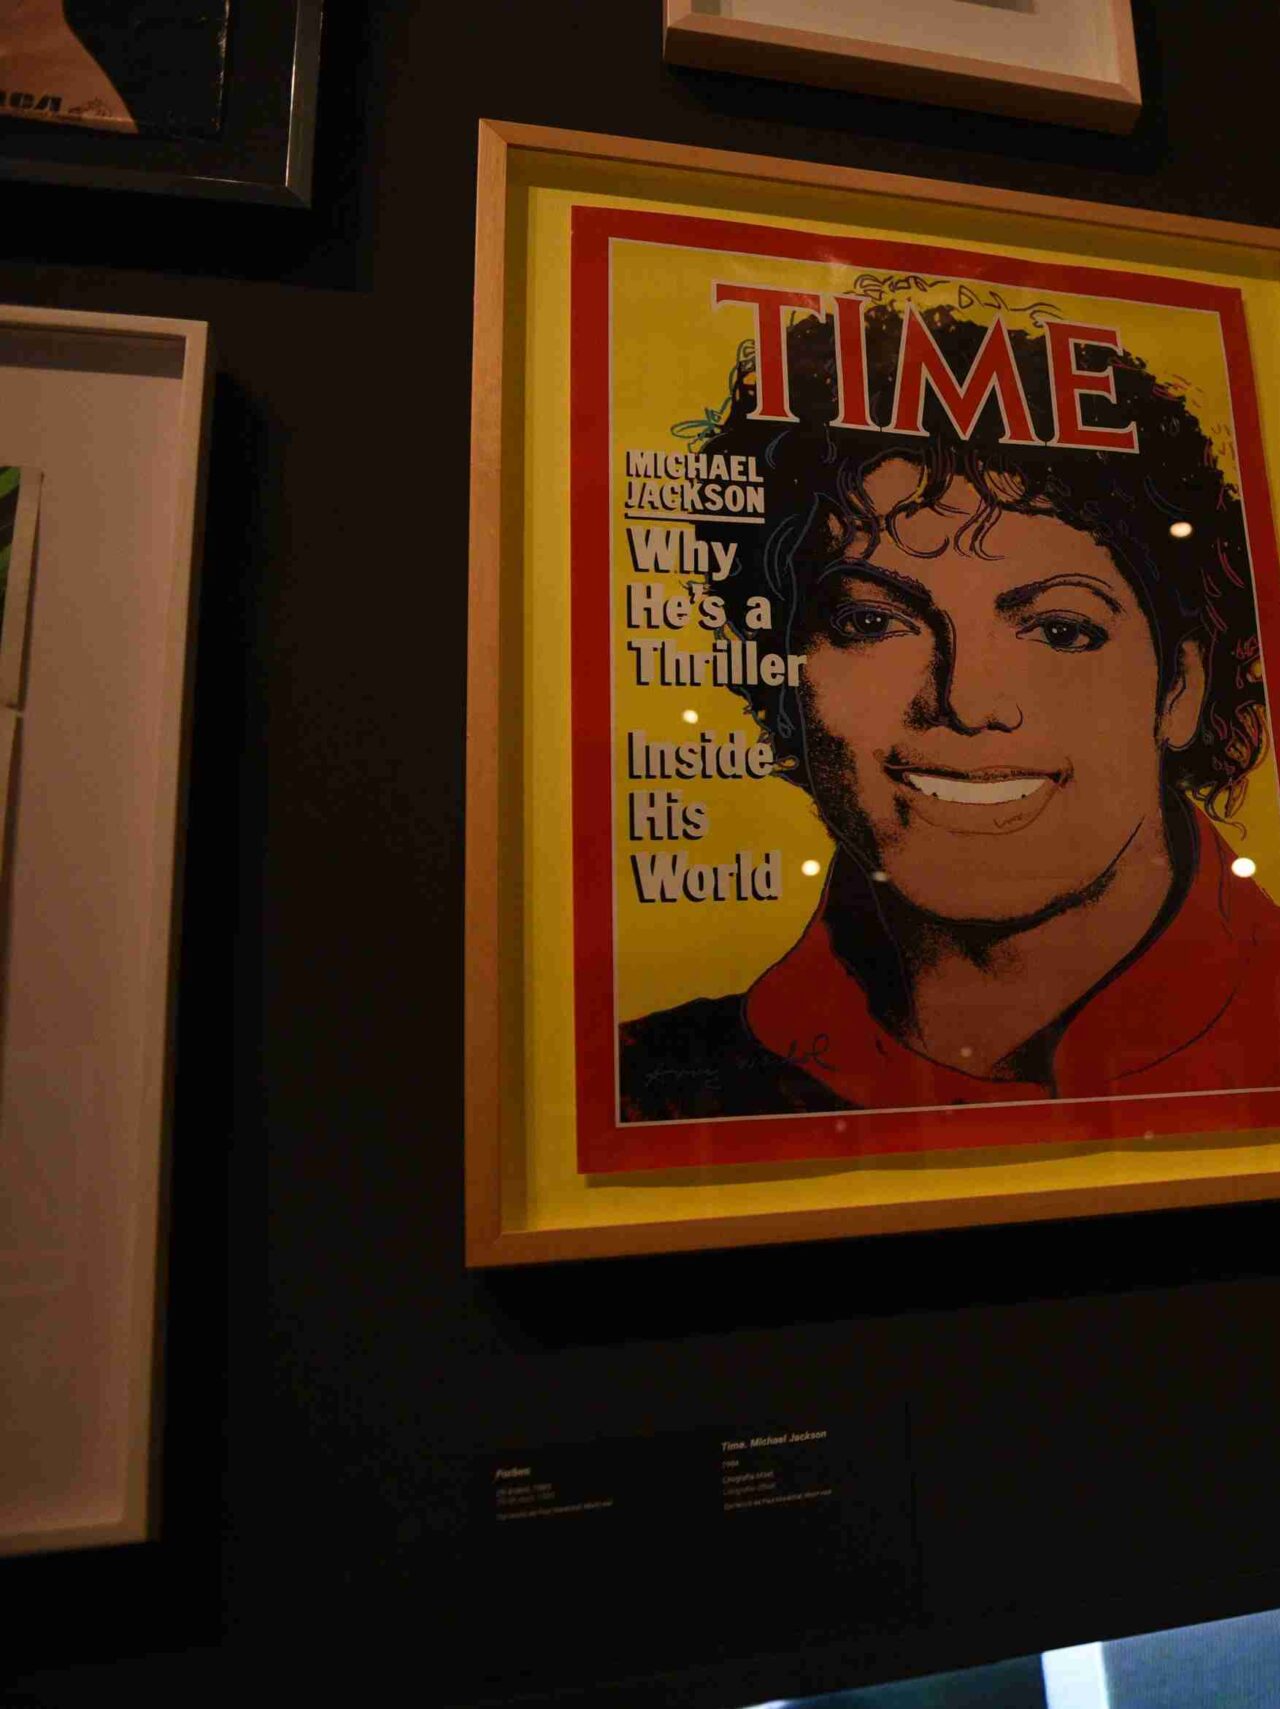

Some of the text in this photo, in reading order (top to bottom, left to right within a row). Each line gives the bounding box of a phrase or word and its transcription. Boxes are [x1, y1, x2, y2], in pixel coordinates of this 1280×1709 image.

[711, 279, 1139, 453] TIME
[626, 450, 765, 483] MICHAEL
[625, 480, 765, 514] JACKSON
[626, 527, 738, 581] Why
[627, 581, 772, 630] He's a
[627, 640, 807, 687] Thriller
[628, 730, 774, 779] Inside
[629, 790, 708, 841] His
[631, 850, 783, 903] World
[750, 1433, 787, 1448] Michael
[788, 1431, 828, 1443] Jackson
